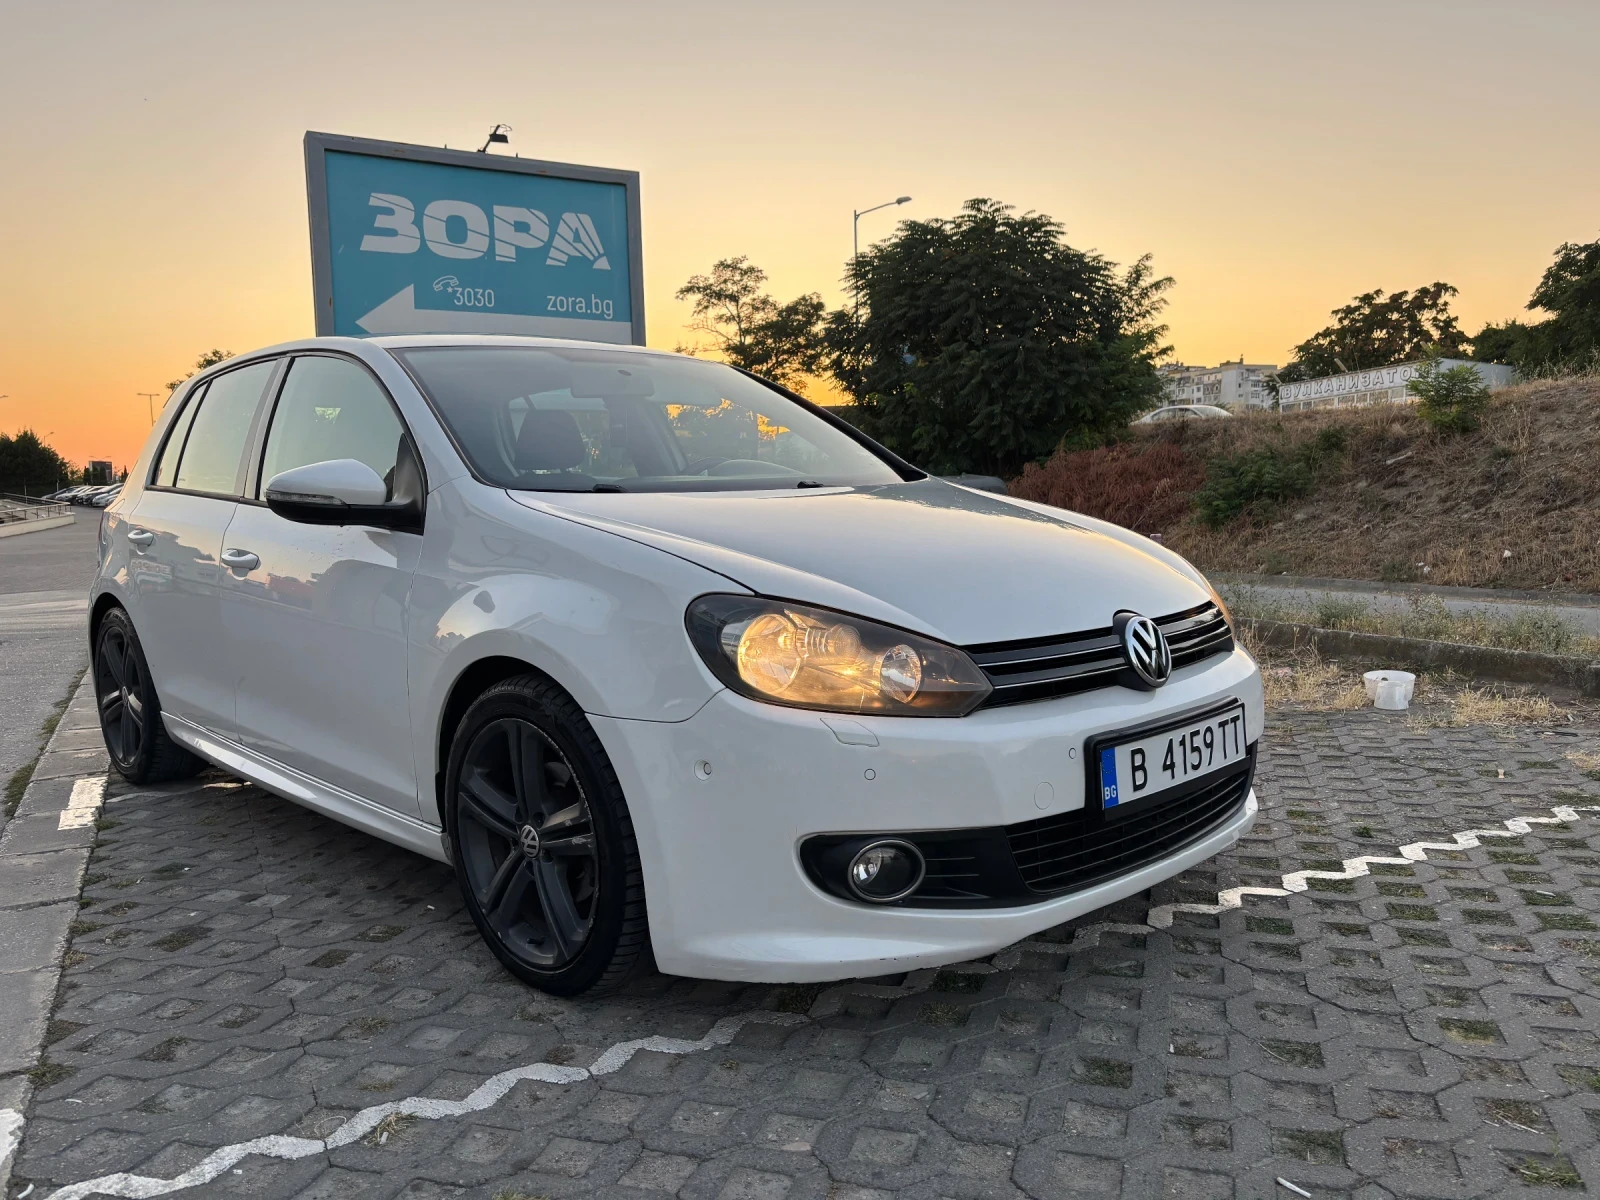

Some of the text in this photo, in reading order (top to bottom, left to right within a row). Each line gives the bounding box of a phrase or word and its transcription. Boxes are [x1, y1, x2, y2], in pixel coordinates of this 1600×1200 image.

[360, 192, 611, 270] ЗОРА
[546, 294, 613, 319] zora.bg
[1104, 785, 1117, 801] BG
